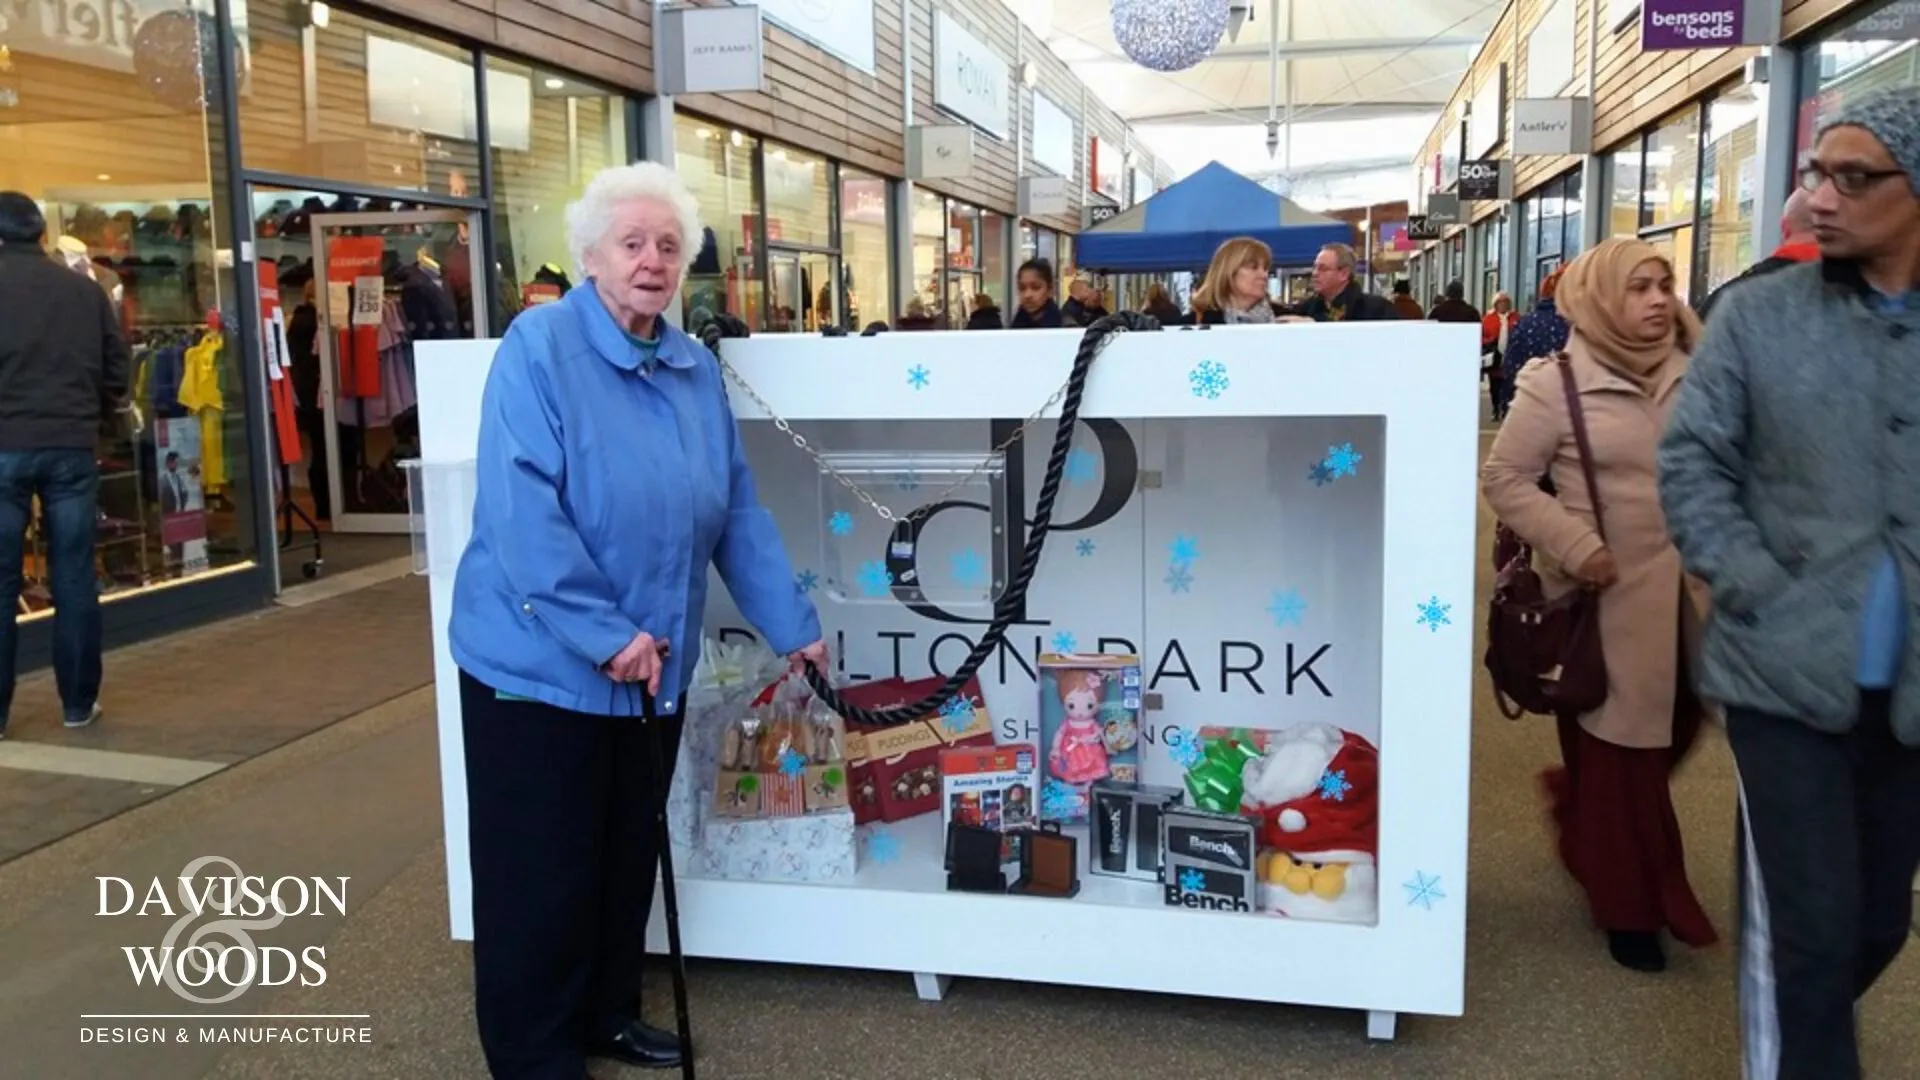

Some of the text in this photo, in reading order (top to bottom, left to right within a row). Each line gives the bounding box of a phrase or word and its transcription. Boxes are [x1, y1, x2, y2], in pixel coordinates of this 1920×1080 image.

[1652, 10, 1734, 26] bensons
[1686, 21, 1733, 39] beds
[692, 44, 754, 55] JEFF BANKS
[956, 50, 998, 110] ROMAN
[877, 728, 931, 749] PUDDINGS
[1109, 808, 1121, 853] Bench
[1189, 835, 1236, 856] Bench
[1165, 883, 1250, 913] Bench
